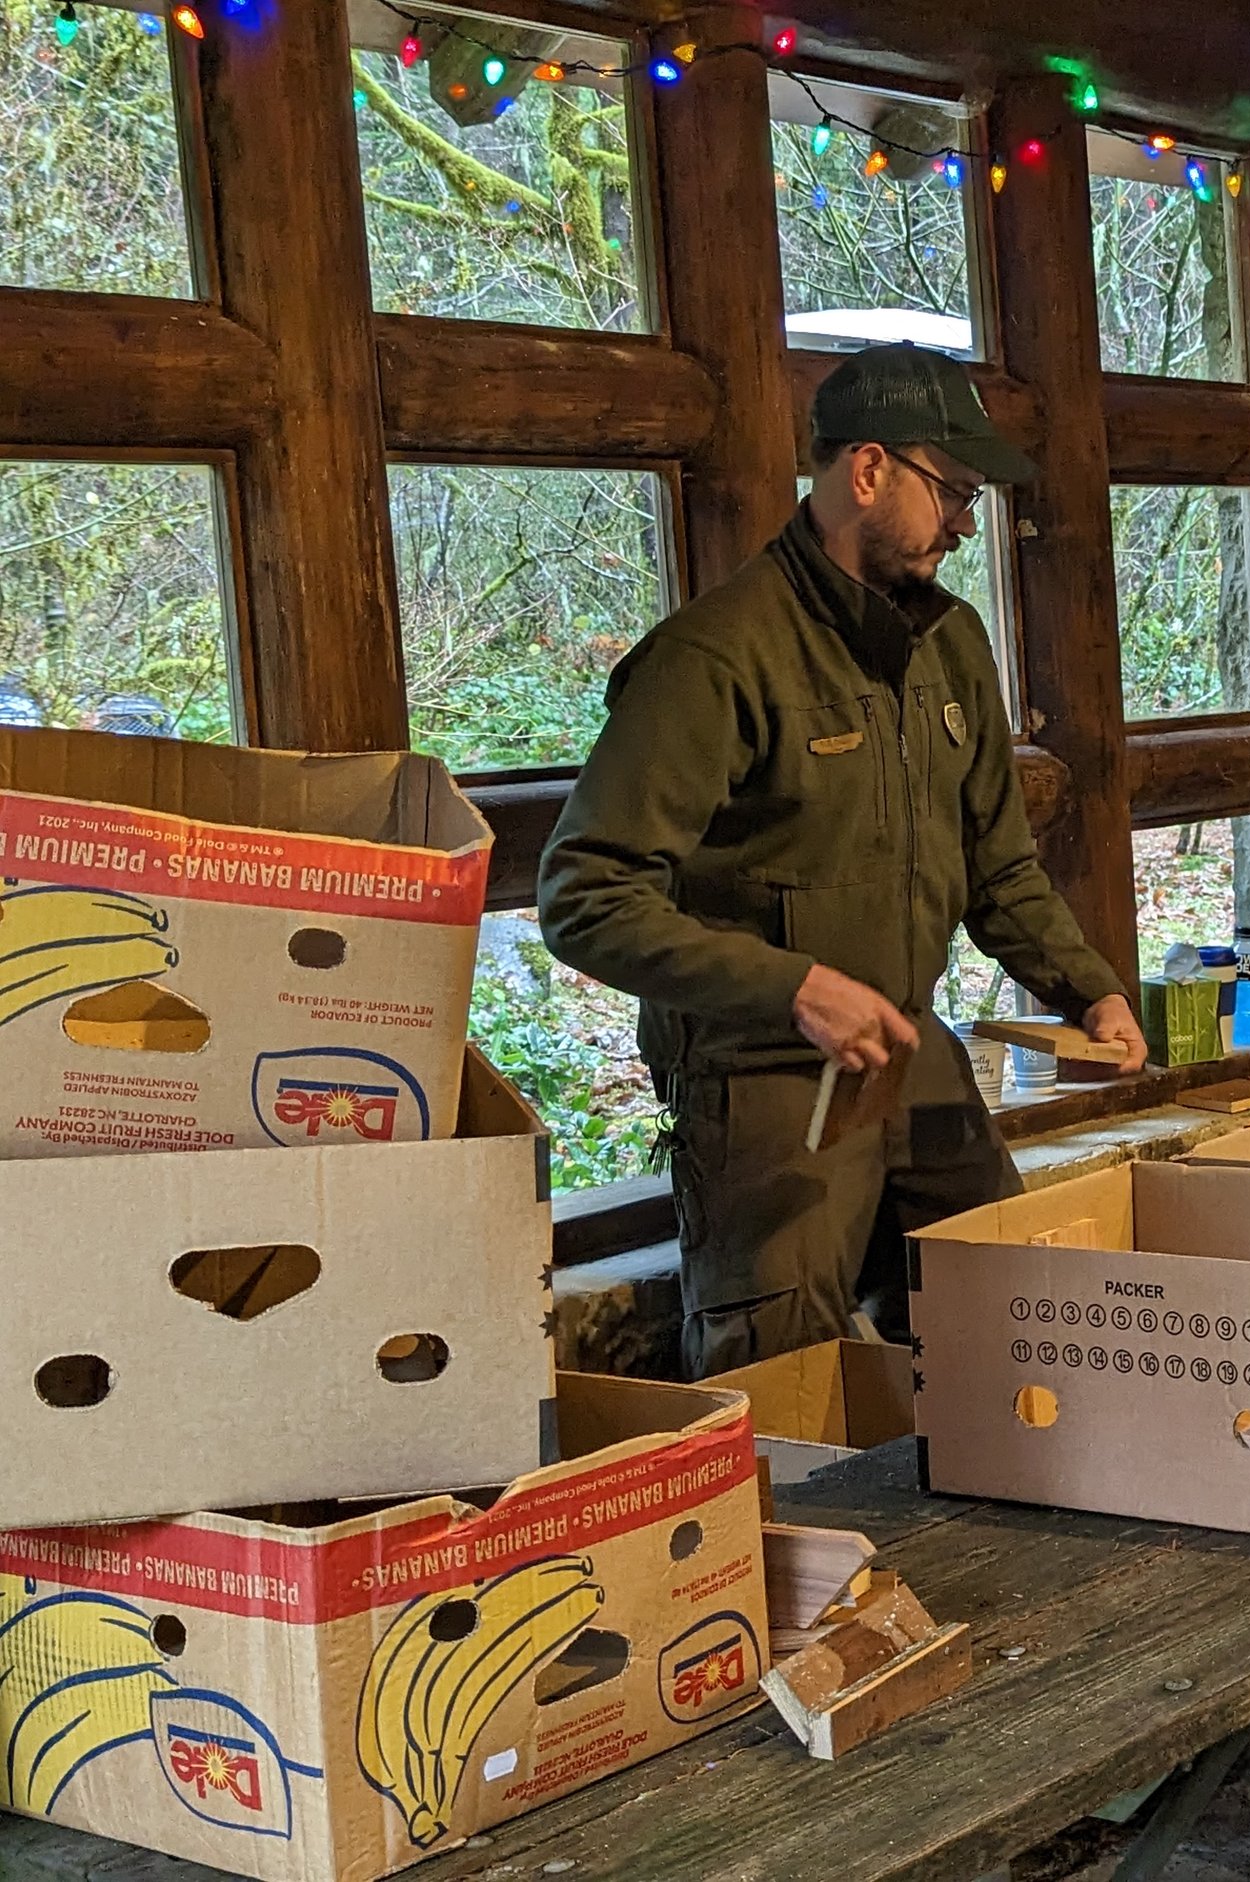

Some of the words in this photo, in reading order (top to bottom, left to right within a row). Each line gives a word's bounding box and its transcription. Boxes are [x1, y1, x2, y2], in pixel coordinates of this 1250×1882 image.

[38, 815, 70, 828] 2021
[101, 822, 162, 840] Company,
[164, 832, 193, 847] Food
[196, 838, 224, 850] Dole
[16, 832, 146, 873] PREMIUM
[251, 845, 270, 855] TM
[167, 854, 292, 889] BANANAS
[300, 867, 423, 903] PREMIUM
[1236, 963, 1249, 973] DE
[278, 993, 295, 1003] kg)
[350, 1000, 361, 1008] 40
[364, 1001, 410, 1013] WEIGHT:
[413, 1006, 434, 1015] NET
[311, 1010, 361, 1022] ECUADOR
[364, 1014, 378, 1024] OF
[381, 1015, 432, 1028] PRODUCT
[63, 1071, 125, 1084] FRESHNESS
[127, 1076, 182, 1090] MAINTAIN
[64, 1083, 109, 1094] APPLIED
[111, 1086, 196, 1101] AZOXYSTROBIN
[185, 1082, 199, 1091] TO
[59, 1106, 96, 1117] 28231
[98, 1109, 116, 1119] NC
[118, 1110, 196, 1126] CHARLOTTE,
[274, 1090, 396, 1141] Dole
[16, 1117, 96, 1133] COMPANY
[100, 1123, 142, 1137] FRUIT
[41, 1131, 60, 1142] By:
[63, 1133, 129, 1148] Dispatched
[146, 1127, 192, 1142] FRESH
[193, 1131, 234, 1144] DOLE
[1105, 1280, 1164, 1299] PACKER
[598, 1474, 616, 1487] Dole
[668, 1453, 733, 1498] PREMIUM
[576, 1481, 596, 1493] Food
[582, 1482, 663, 1528] BANANAS
[488, 1510, 511, 1522] 2021
[474, 1515, 567, 1562] PREMIUM
[62, 1544, 130, 1576] PREMIUM
[144, 1556, 217, 1591] BANANAS
[362, 1545, 467, 1590] BANANAS
[221, 1570, 299, 1605] PREMIUM
[673, 1647, 744, 1707] Dole
[171, 1741, 262, 1811] Dole
